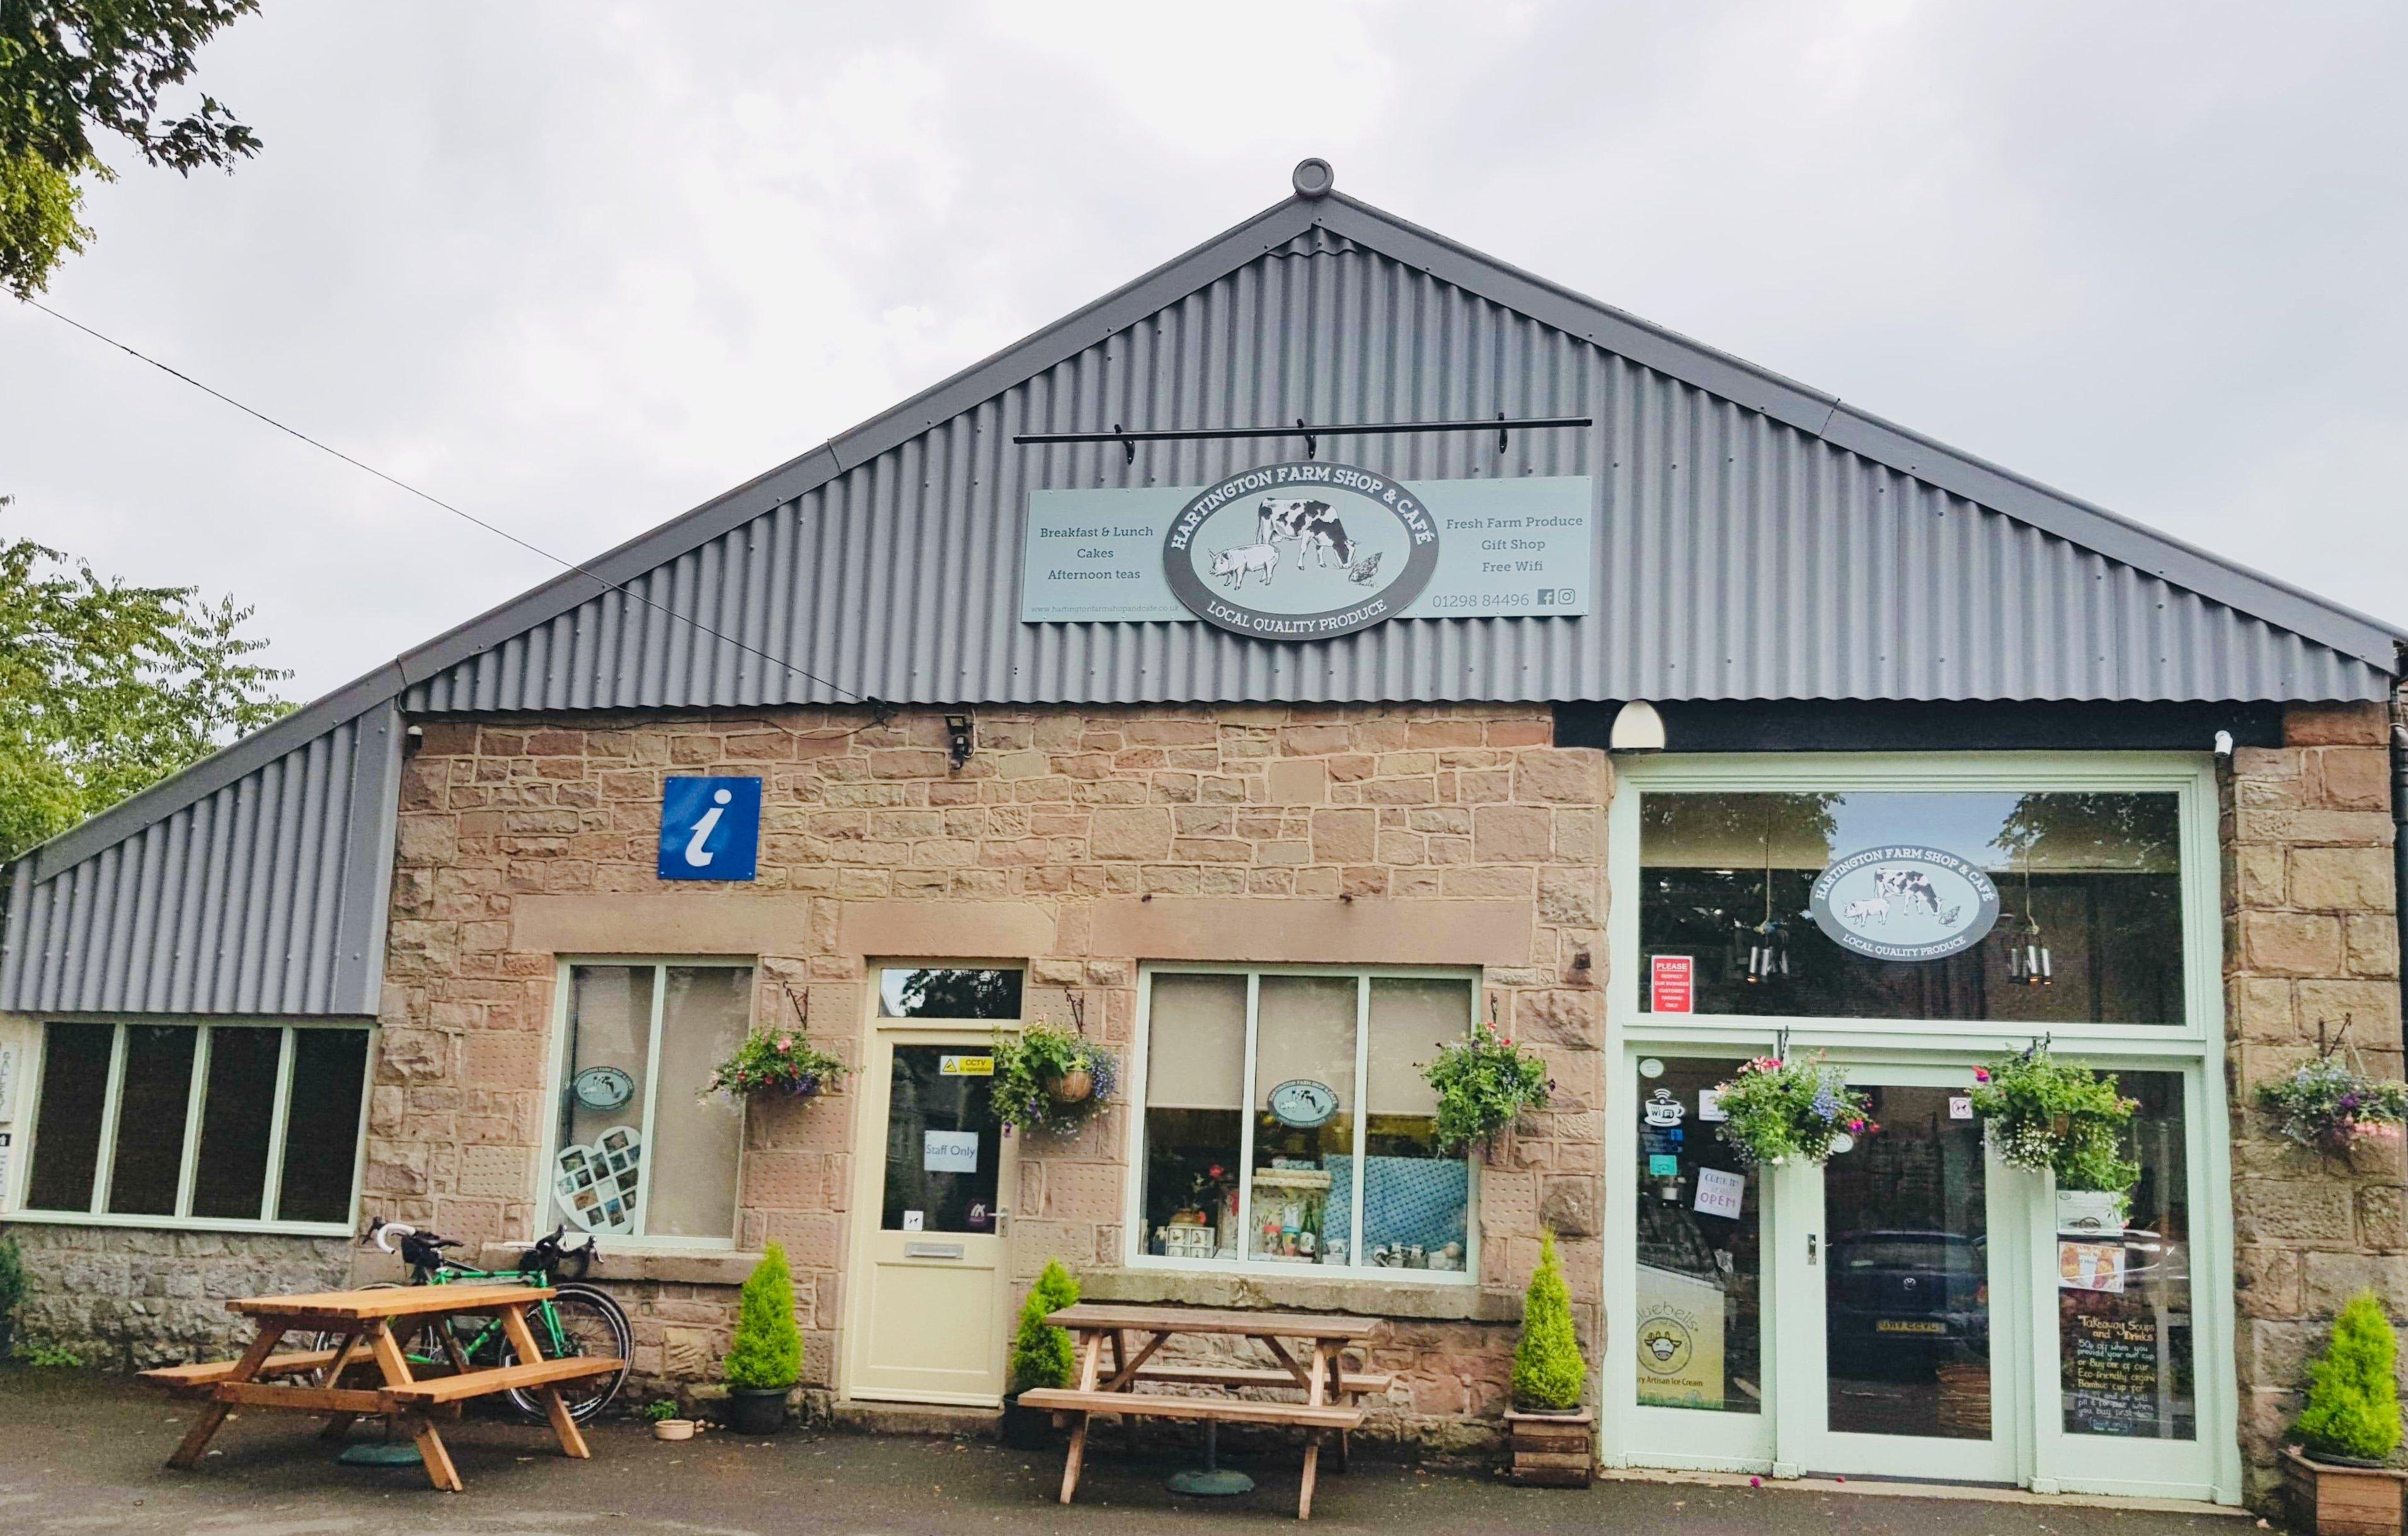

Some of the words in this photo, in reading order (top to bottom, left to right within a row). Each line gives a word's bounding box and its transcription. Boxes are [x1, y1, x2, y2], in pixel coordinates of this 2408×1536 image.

[1171, 469, 1273, 550] HARTINGTON
[1276, 466, 1331, 483] FARM
[1333, 469, 1384, 494] SHOP
[1382, 489, 1397, 505] &
[1396, 499, 1436, 546] CAFÉ
[1446, 518, 1482, 530] Fresh
[1487, 517, 1522, 528] Farm
[1526, 516, 1583, 527] Produce
[1040, 527, 1098, 538] Breakfast
[1101, 527, 1109, 537] &
[1113, 526, 1154, 537] Lunch
[1482, 539, 1506, 551] Gift
[1510, 539, 1545, 552] Shop
[1077, 549, 1114, 559] Cakes
[1482, 562, 1511, 573] Free
[1515, 561, 1544, 571] Wifi
[1048, 570, 1112, 581] Afternoon
[1116, 570, 1140, 580] teas
[1433, 595, 1477, 608] 01298
[1482, 593, 1530, 607] 84496
[1207, 600, 1250, 628] LOCAL
[1253, 619, 1316, 634] QUALITY
[1319, 599, 1387, 631] PRODUCE
[1815, 851, 1884, 901] HARTINGTON
[1885, 848, 1923, 860] FARM
[1924, 850, 1959, 870] SHOP
[1958, 864, 1969, 876] &
[1968, 871, 1997, 902] CAFÉ
[1842, 934, 1874, 953] LOCAL
[1875, 946, 1920, 957] QUALITY
[1921, 936, 1966, 956] PRODUCE
[926, 1144, 948, 1155] Staff
[951, 1145, 976, 1159] Only
[1700, 1192, 1736, 1208] OPEN
[2078, 1315, 2125, 1335] Takeaway
[2128, 1321, 2155, 1333] Soups
[2092, 1329, 2111, 1339] and
[2124, 1331, 2154, 1341] Drinks
[2097, 1343, 2107, 1353] off
[2111, 1341, 2129, 1351] when
[2134, 1346, 2148, 1354] you
[2107, 1351, 2123, 1361] your
[2089, 1358, 2104, 1370] Buy
[2122, 1363, 2131, 1372] of
[1647, 1376, 1670, 1385] Artisan
[1682, 1378, 1703, 1387] Cream
[2078, 1368, 2127, 1382] Eco-friendly
[2131, 1385, 2145, 1394] for
